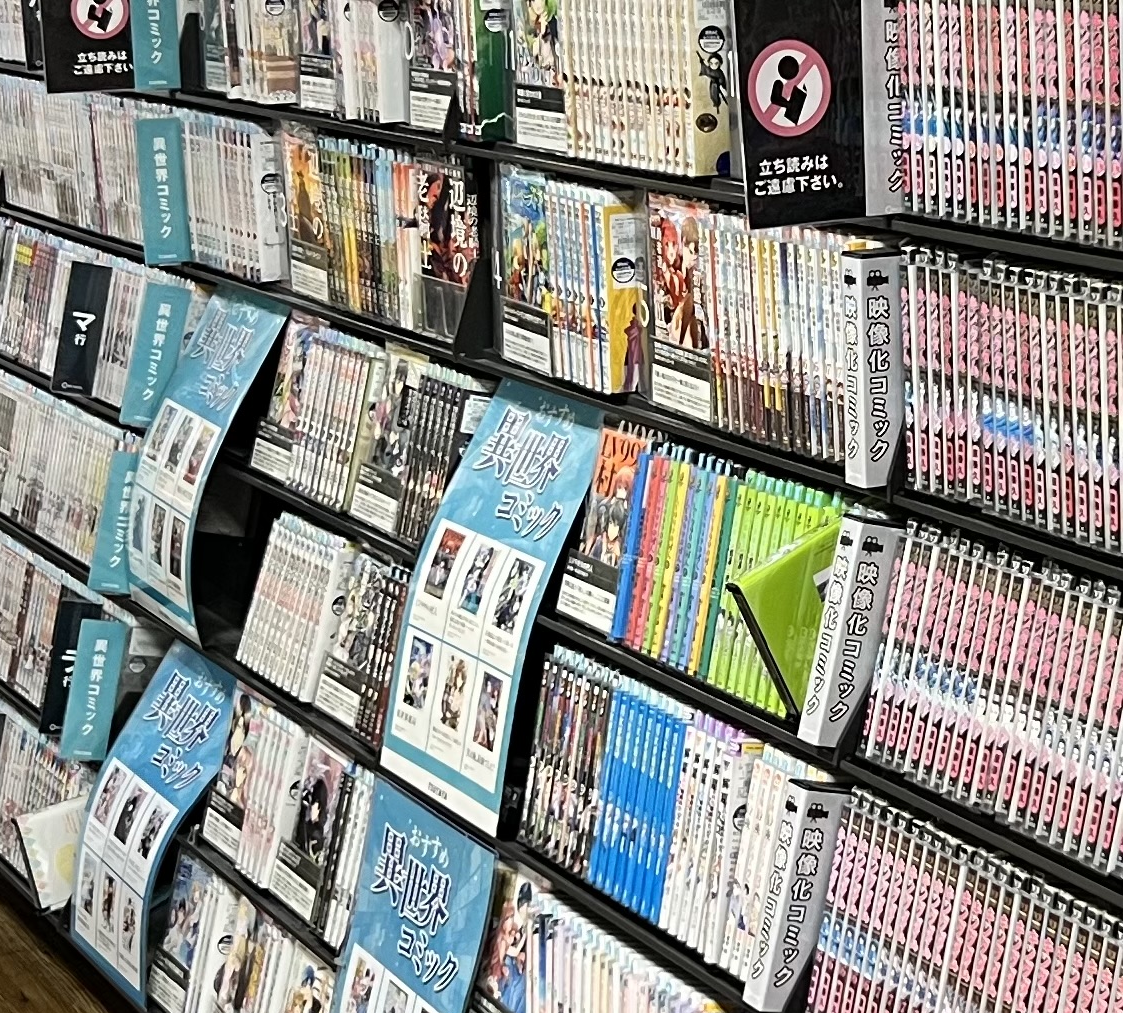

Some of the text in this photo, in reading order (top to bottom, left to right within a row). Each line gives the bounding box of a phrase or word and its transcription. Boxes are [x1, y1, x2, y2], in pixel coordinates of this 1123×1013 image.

[77, 50, 127, 64] 立ち読みは
[152, 135, 173, 240] 異世界コミック
[754, 173, 844, 197] ご遠慮下さい。
[759, 153, 829, 177] 立ち読みは
[448, 178, 469, 278] 辺境の
[71, 309, 97, 348] マ行
[142, 302, 172, 402] 異世界コミック
[843, 295, 860, 460] 映像化コミック
[866, 296, 889, 463] 映像化コミック
[472, 405, 572, 494] 異世界
[495, 490, 564, 543] コミック
[805, 554, 849, 716] 映像化コミック
[829, 562, 881, 723] 映像化コミック
[80, 638, 110, 737] 異世界コミック
[143, 669, 222, 753] 異世界
[150, 743, 205, 790] コミック
[371, 821, 453, 937] 異世界
[409, 825, 452, 867] おすすめ
[750, 820, 792, 980] 映像化コミック
[773, 827, 825, 988] 映像化コミック
[396, 924, 460, 994] コミック
